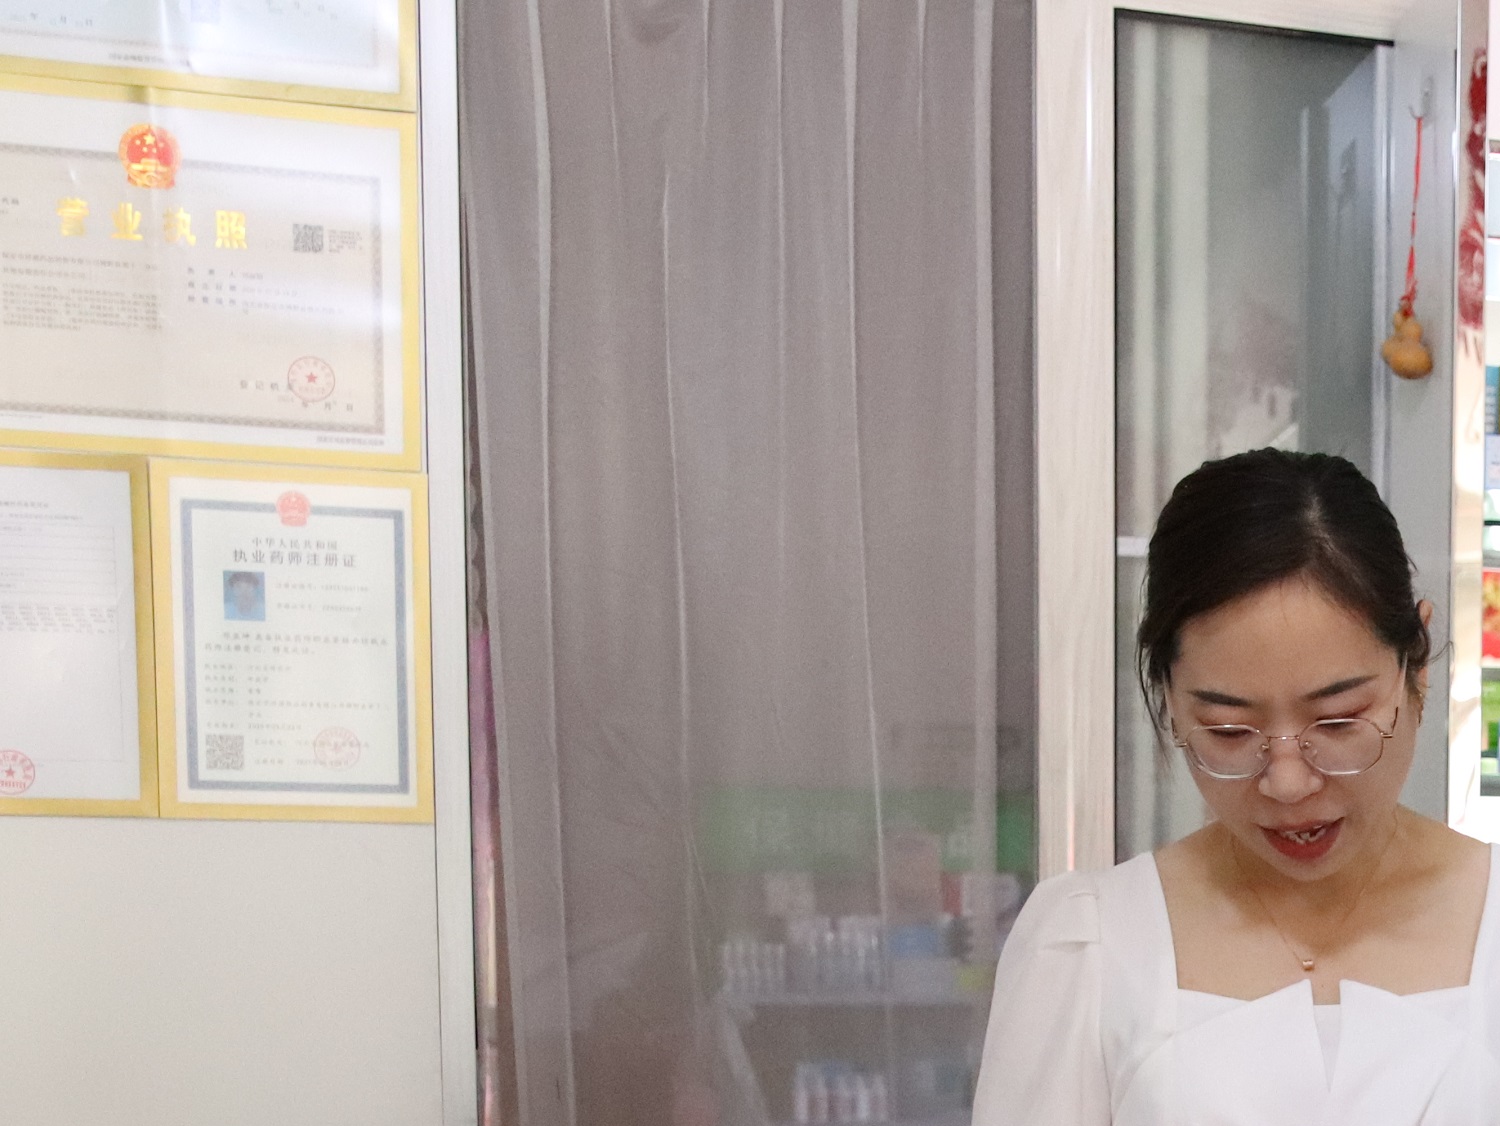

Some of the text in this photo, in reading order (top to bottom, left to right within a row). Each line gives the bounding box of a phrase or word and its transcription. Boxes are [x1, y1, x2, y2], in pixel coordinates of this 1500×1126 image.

[56, 196, 250, 250] 营业执照
[251, 537, 339, 551] 中华人民共和国
[233, 548, 357, 569] 执业药师注册证
